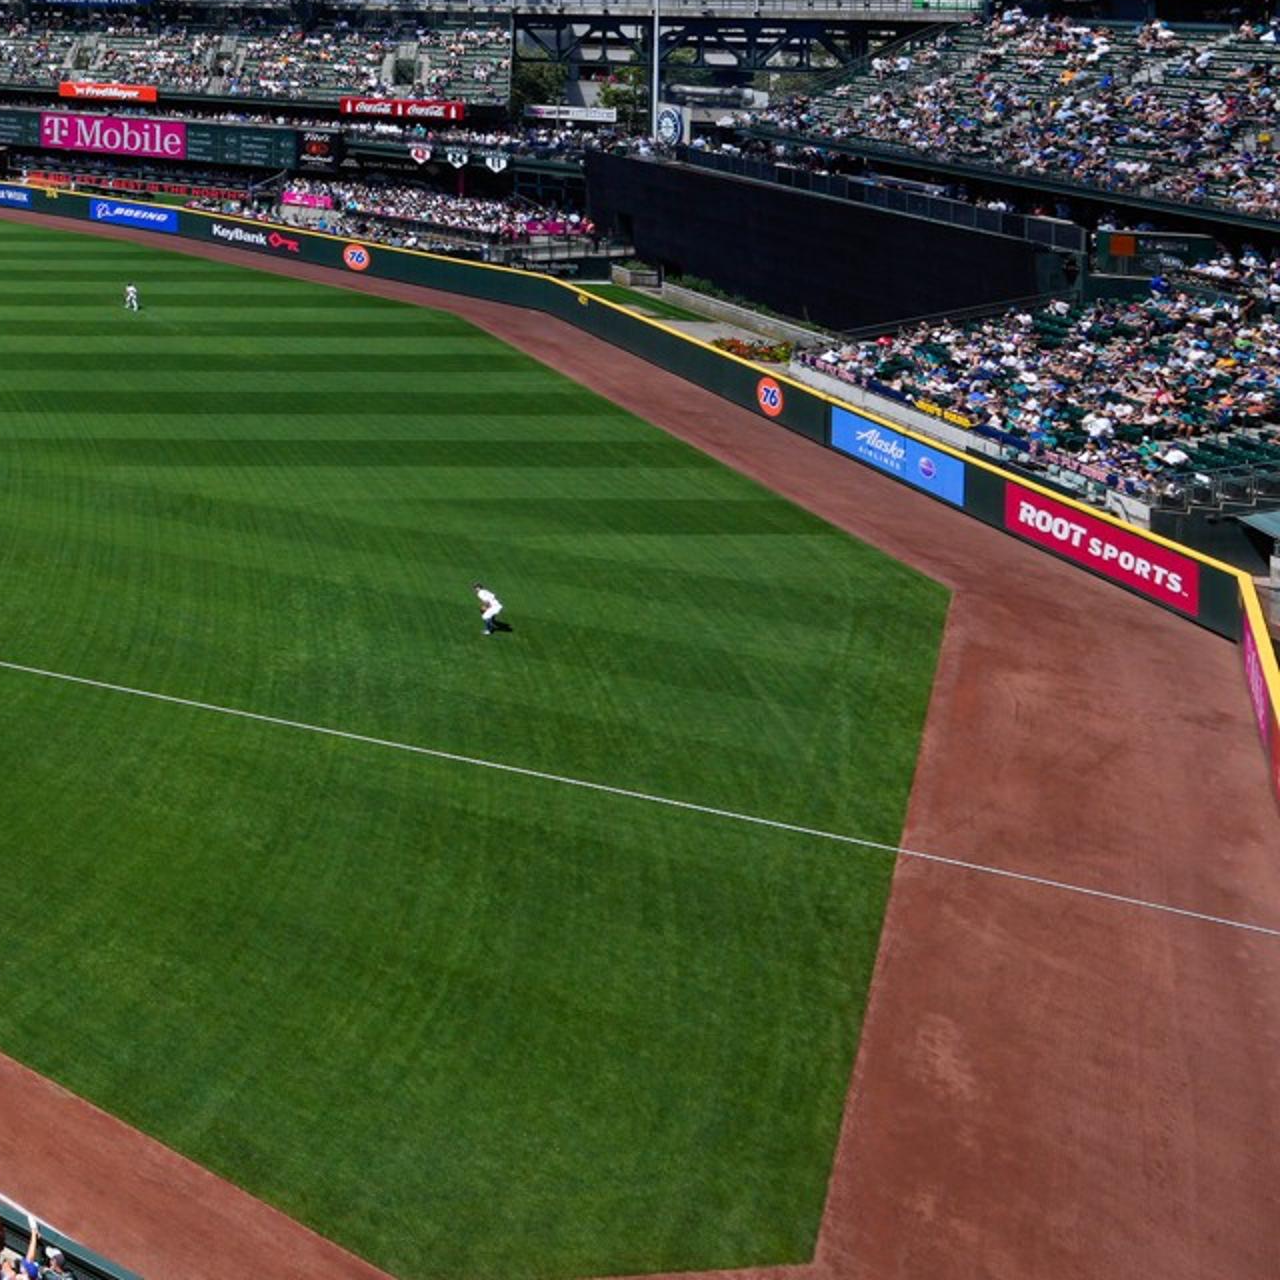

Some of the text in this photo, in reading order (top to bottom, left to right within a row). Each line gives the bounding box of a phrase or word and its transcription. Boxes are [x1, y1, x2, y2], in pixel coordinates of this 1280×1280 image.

[44, 116, 69, 145] T
[75, 118, 182, 155] Mobile
[113, 207, 168, 222] BOEING
[212, 223, 267, 246] KeyBank
[349, 251, 365, 263] 76
[763, 387, 779, 406] 76
[855, 429, 906, 459] Alaska
[858, 446, 901, 470] AIRLINES
[1018, 500, 1183, 593] ROOT SPORTS
